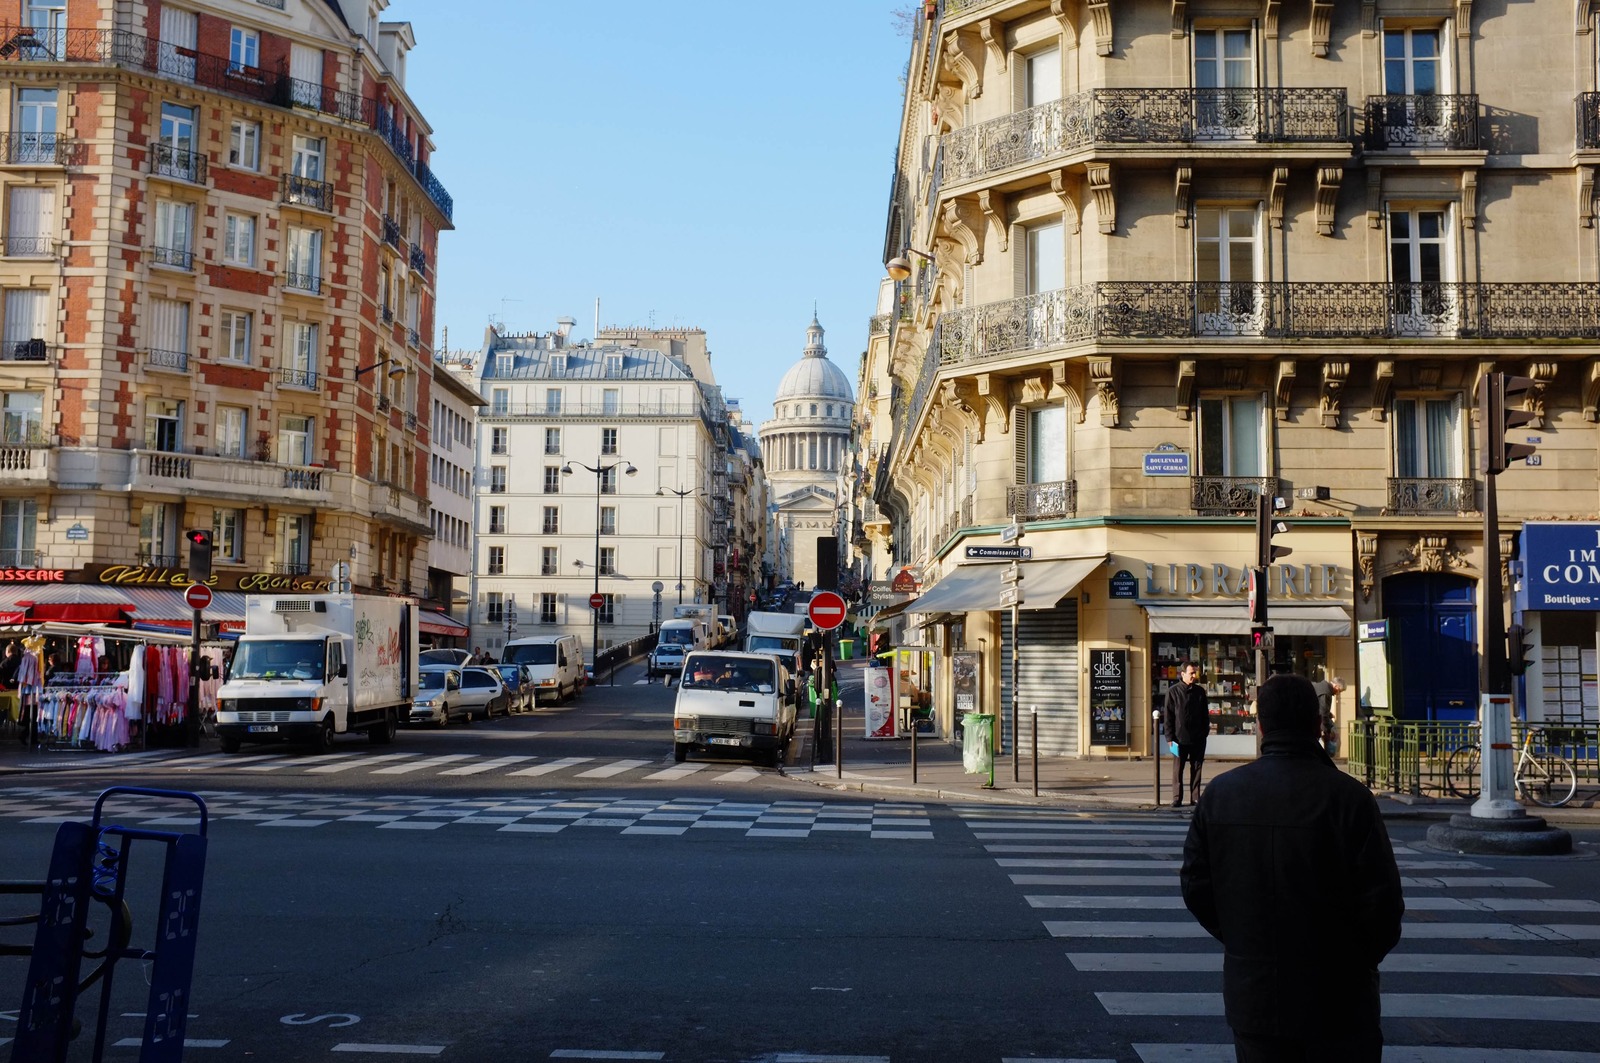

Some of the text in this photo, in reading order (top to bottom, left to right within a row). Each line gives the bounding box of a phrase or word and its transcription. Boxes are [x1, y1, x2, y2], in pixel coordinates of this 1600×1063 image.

[1527, 455, 1540, 465] 49
[1301, 488, 1314, 498] 49
[979, 548, 1019, 556] Commissariat
[1144, 563, 1338, 595] LIBRARIE
[872, 593, 895, 601] Styliste
[1544, 594, 1591, 605] Boutiques
[1100, 651, 1115, 664] THE
[1093, 663, 1122, 676] SHOES
